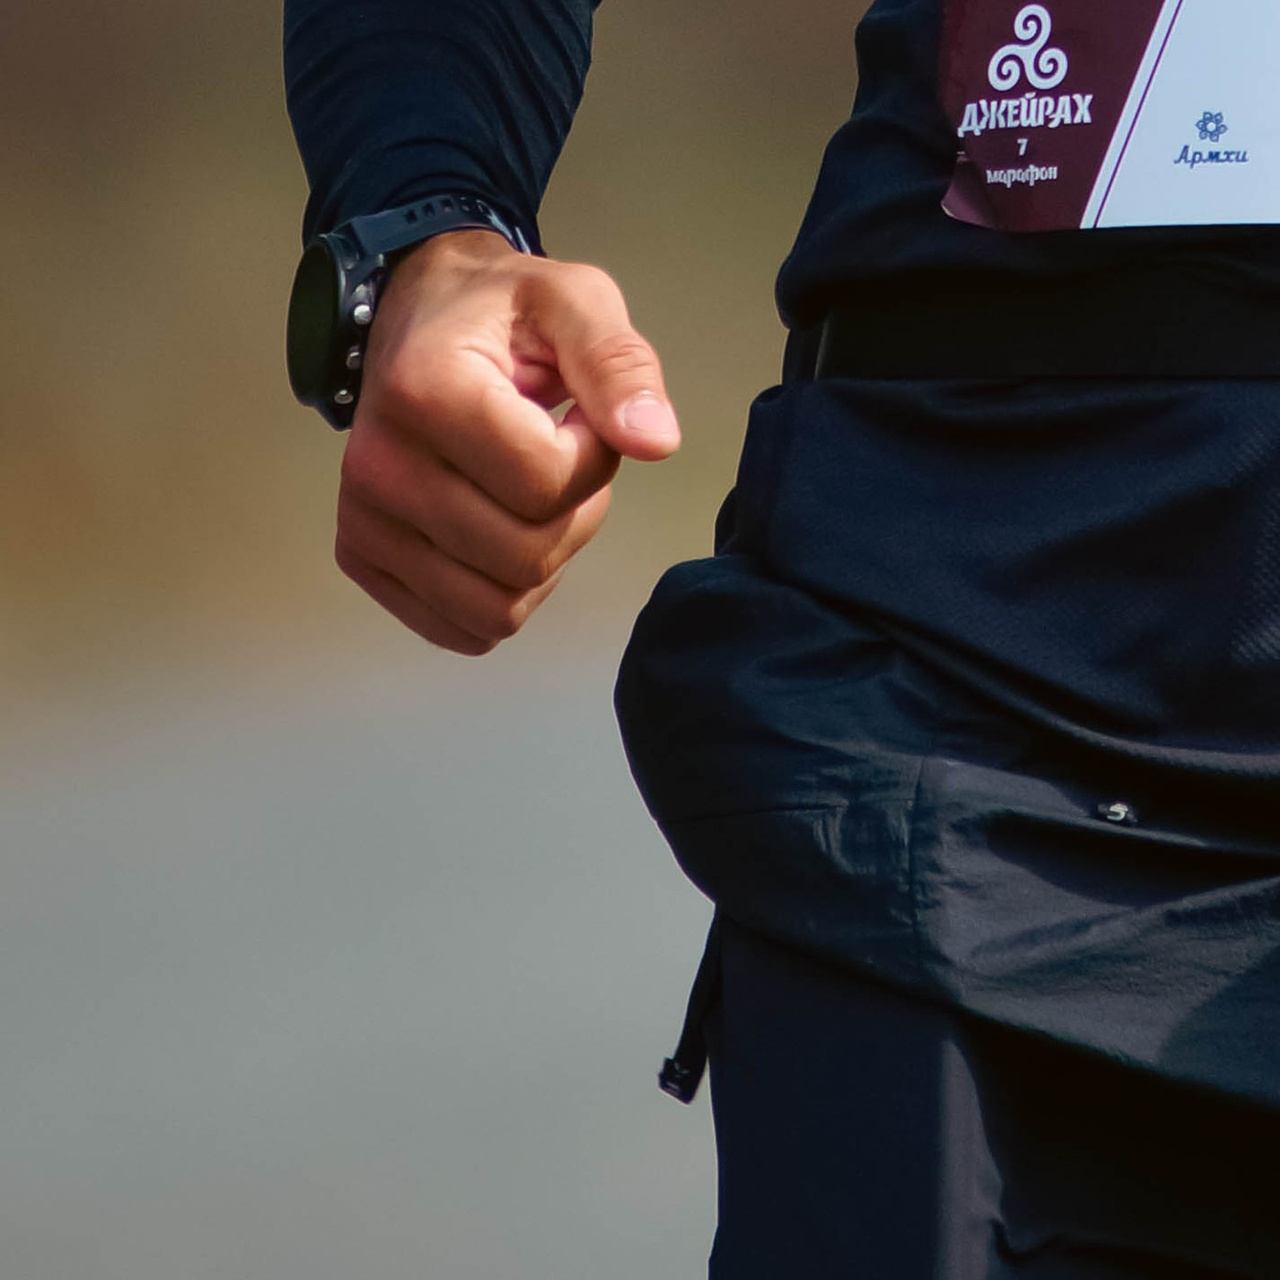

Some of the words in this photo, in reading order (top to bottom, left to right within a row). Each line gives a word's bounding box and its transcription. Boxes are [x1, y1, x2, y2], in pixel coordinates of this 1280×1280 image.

[957, 92, 1094, 138] ДЖЕЙРАХ
[1016, 138, 1028, 156] 7
[985, 164, 1059, 188] марафон
